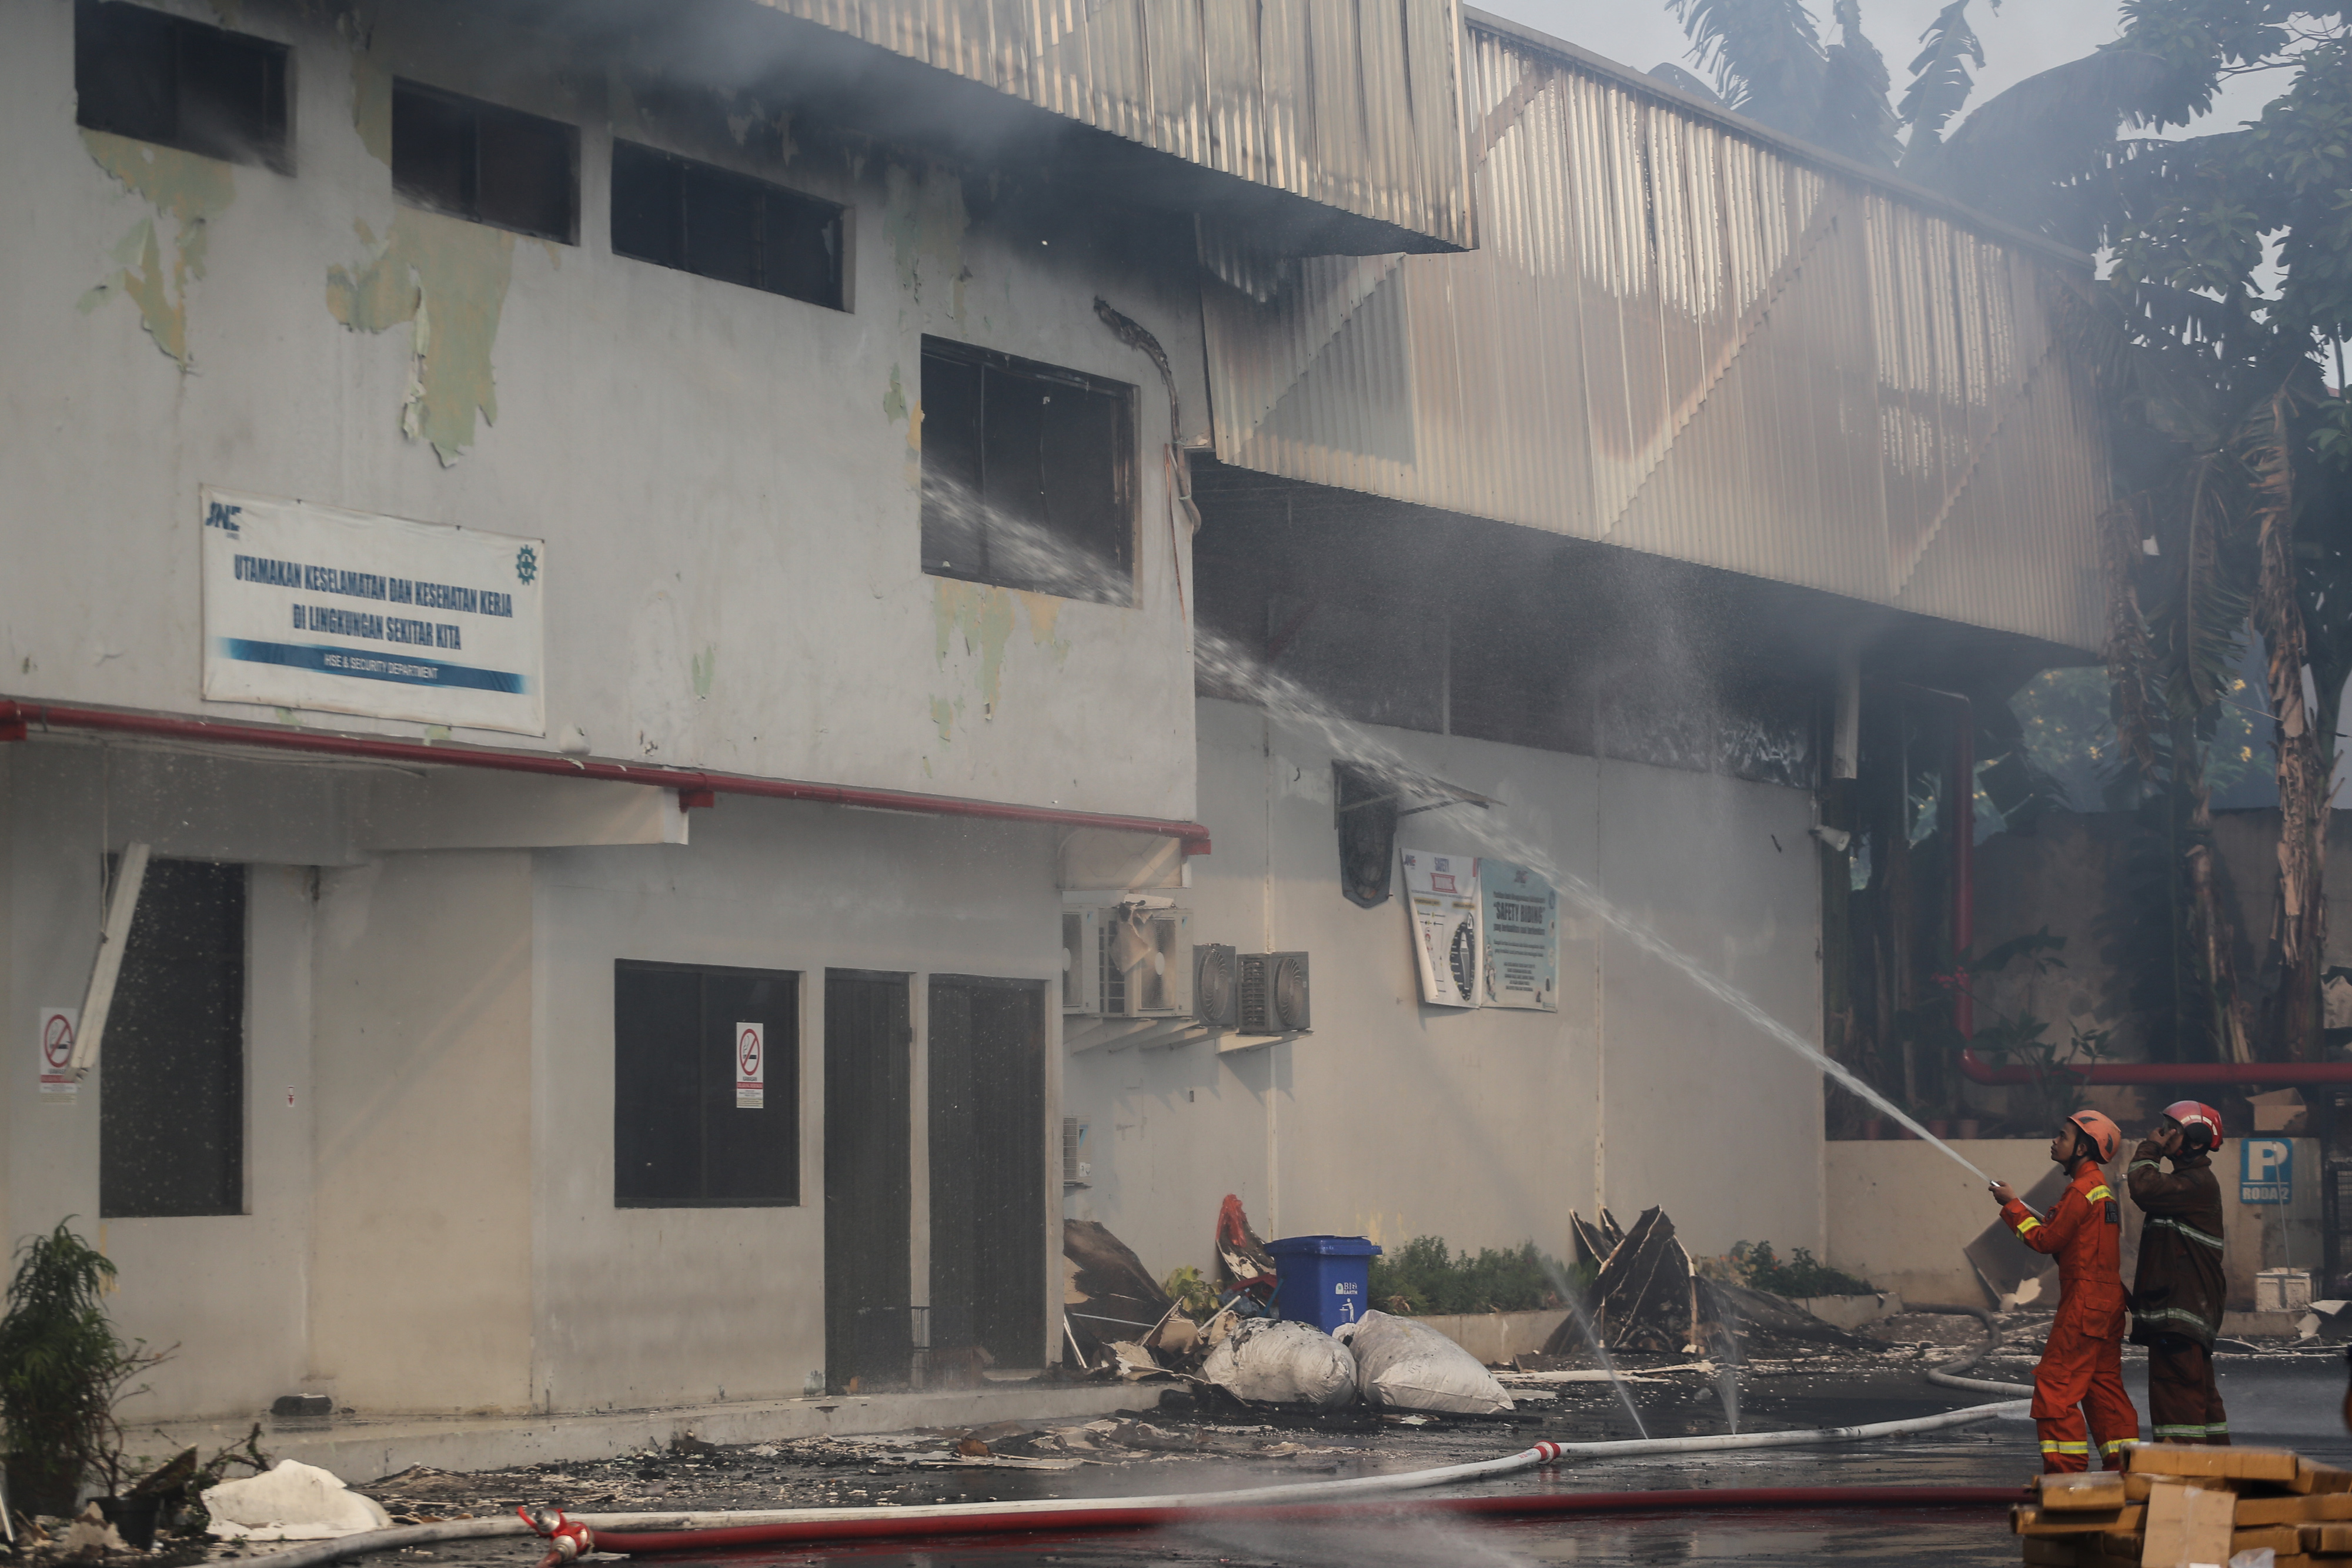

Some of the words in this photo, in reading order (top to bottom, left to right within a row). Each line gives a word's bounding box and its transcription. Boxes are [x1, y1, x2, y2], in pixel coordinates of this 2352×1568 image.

[206, 502, 242, 532] JNE
[234, 554, 303, 589] UTAMAKAN
[305, 564, 386, 601] KESELAMATAN
[389, 577, 413, 604] DAN
[415, 581, 477, 613] KESEHATAN
[480, 590, 513, 618] KERJA
[293, 603, 306, 629] DI
[309, 606, 384, 640] LINGKUNGAN
[386, 616, 433, 646] SEKITAR
[436, 623, 462, 650] KITA
[324, 653, 342, 667] HSE
[343, 656, 349, 668] &
[349, 657, 388, 673] SECURITY
[388, 663, 439, 680] DEPARTMENT
[2249, 1141, 2288, 1180] P
[2243, 1187, 2278, 1200] RODA
[2280, 1188, 2289, 1199] 2
